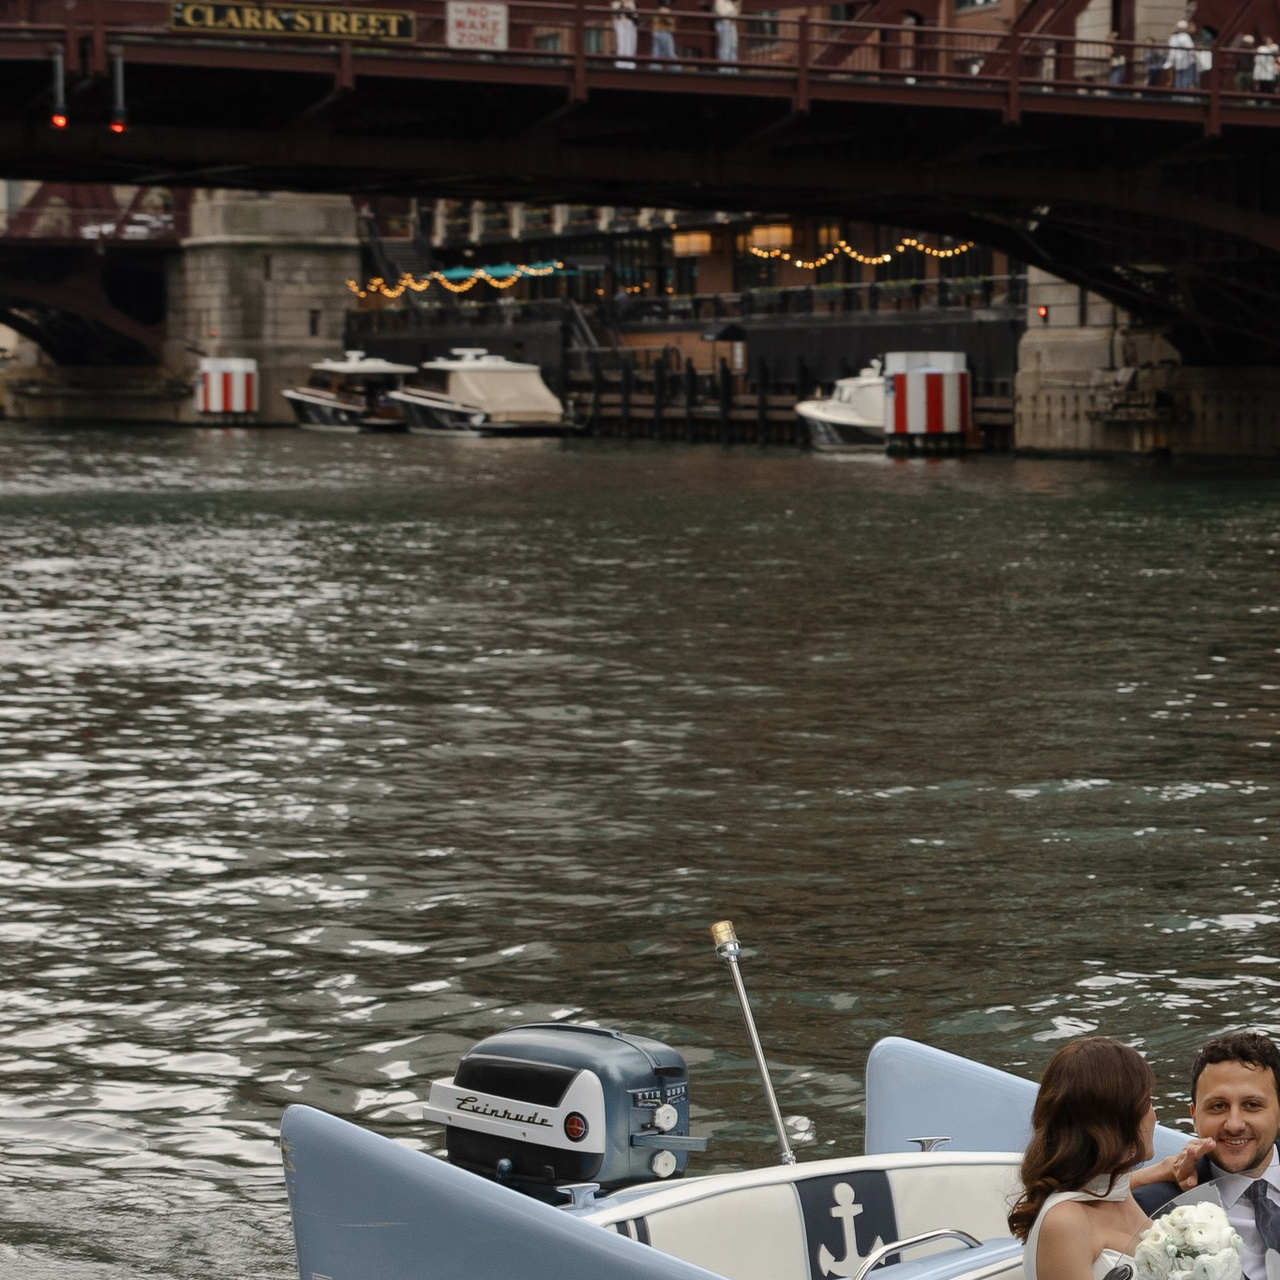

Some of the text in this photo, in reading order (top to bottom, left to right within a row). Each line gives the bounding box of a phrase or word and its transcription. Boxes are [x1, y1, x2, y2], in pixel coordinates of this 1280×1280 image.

[183, 4, 404, 36] CLARK STREET
[456, 1097, 554, 1127] Evinrude
